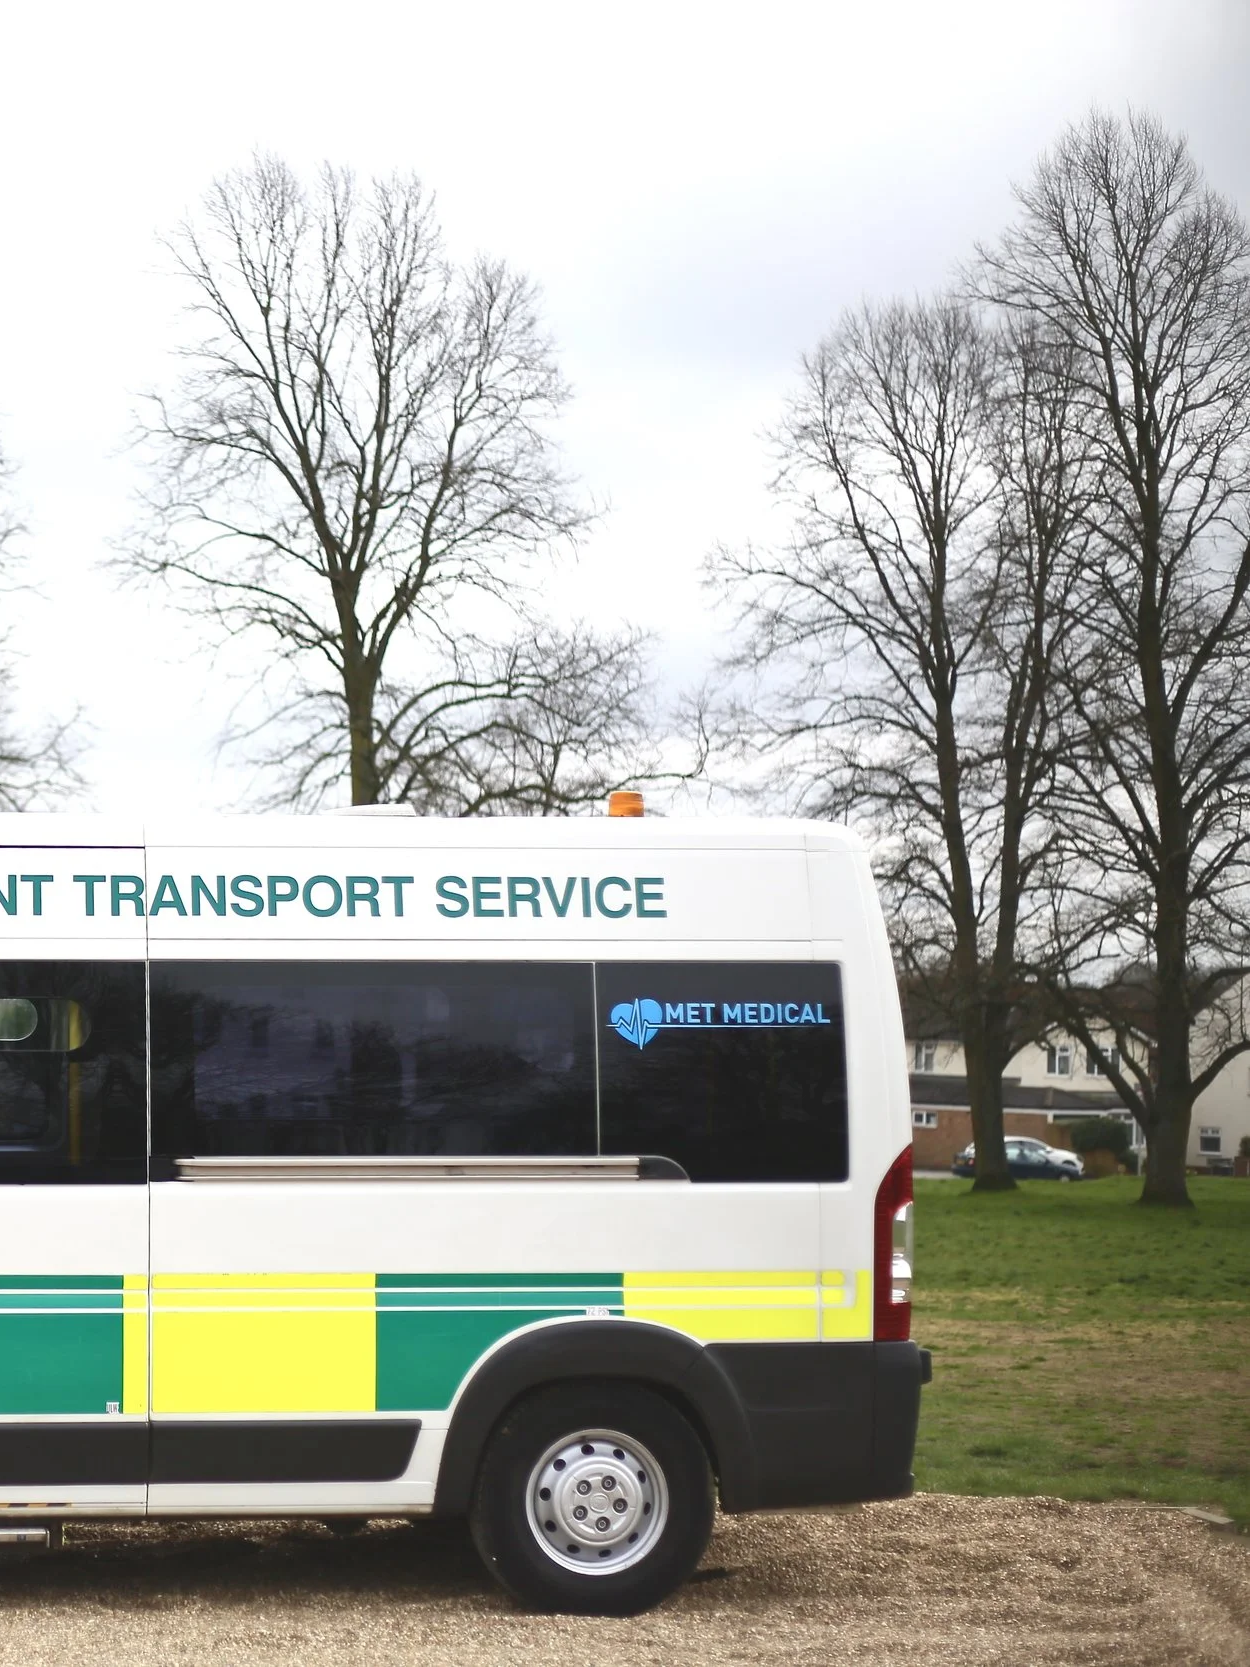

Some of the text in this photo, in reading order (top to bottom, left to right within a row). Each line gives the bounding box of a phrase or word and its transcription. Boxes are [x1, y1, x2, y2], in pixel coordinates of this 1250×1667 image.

[74, 875, 414, 917] TRANSPORT
[437, 876, 666, 918] SERVICE
[665, 1003, 831, 1024] MET MEDICAL
